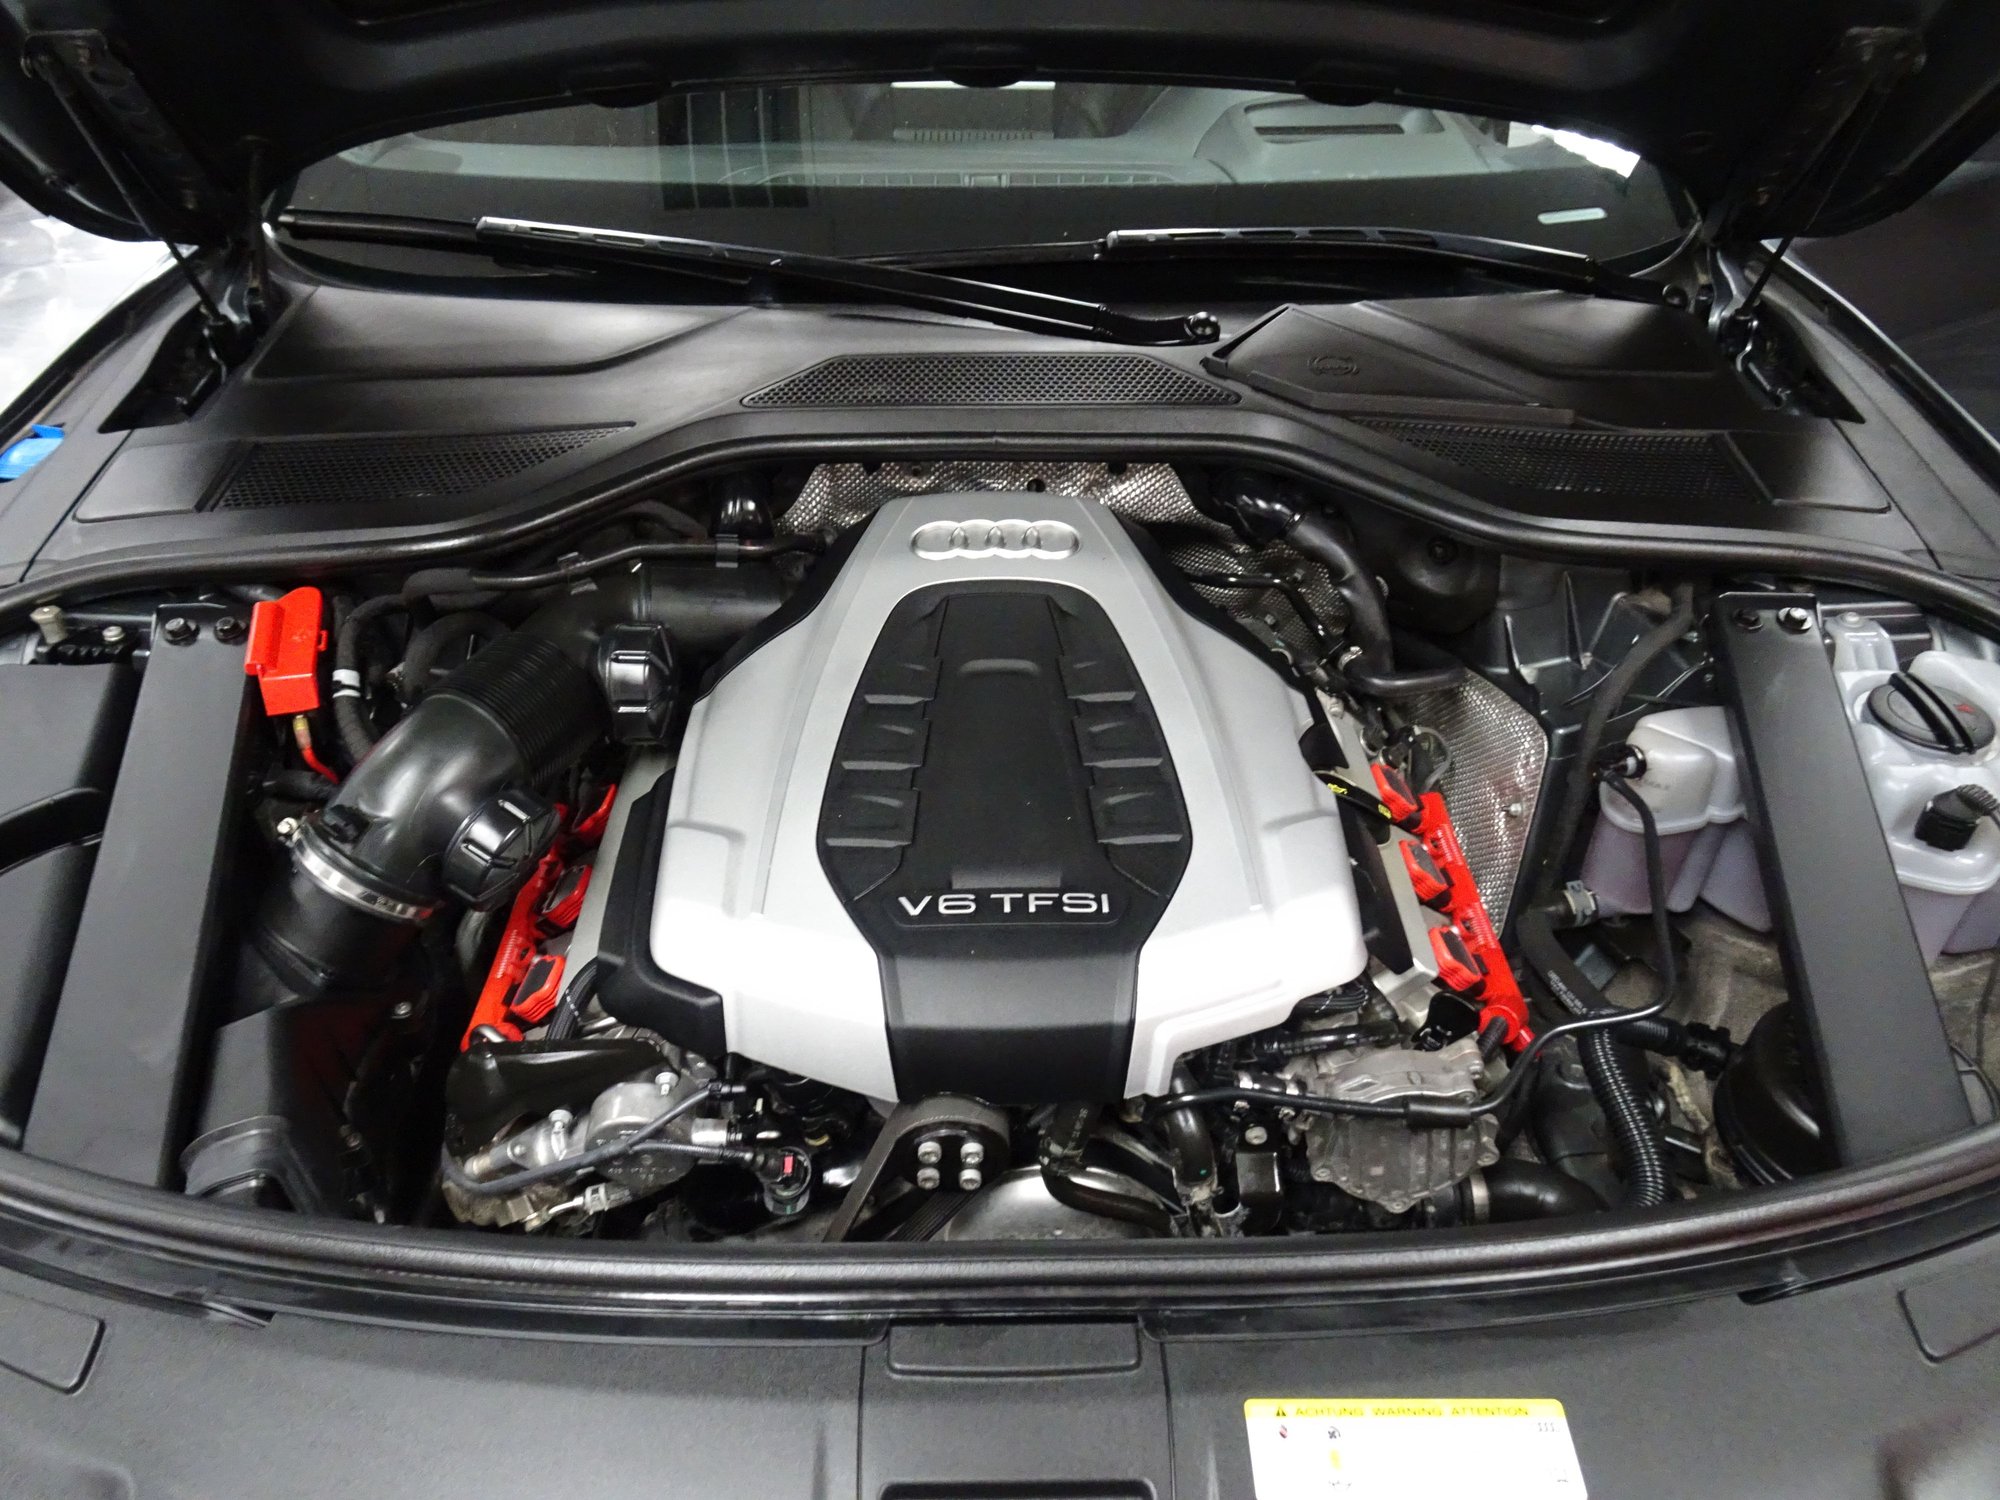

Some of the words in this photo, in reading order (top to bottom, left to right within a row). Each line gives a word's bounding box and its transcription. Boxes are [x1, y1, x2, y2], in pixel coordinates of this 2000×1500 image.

[898, 894, 976, 916] V6
[990, 893, 1110, 914] TFSI
[1295, 1407, 1364, 1416] ACHTUNG
[1372, 1407, 1442, 1416] WARNING
[1451, 1407, 1528, 1416] ATTENTION
